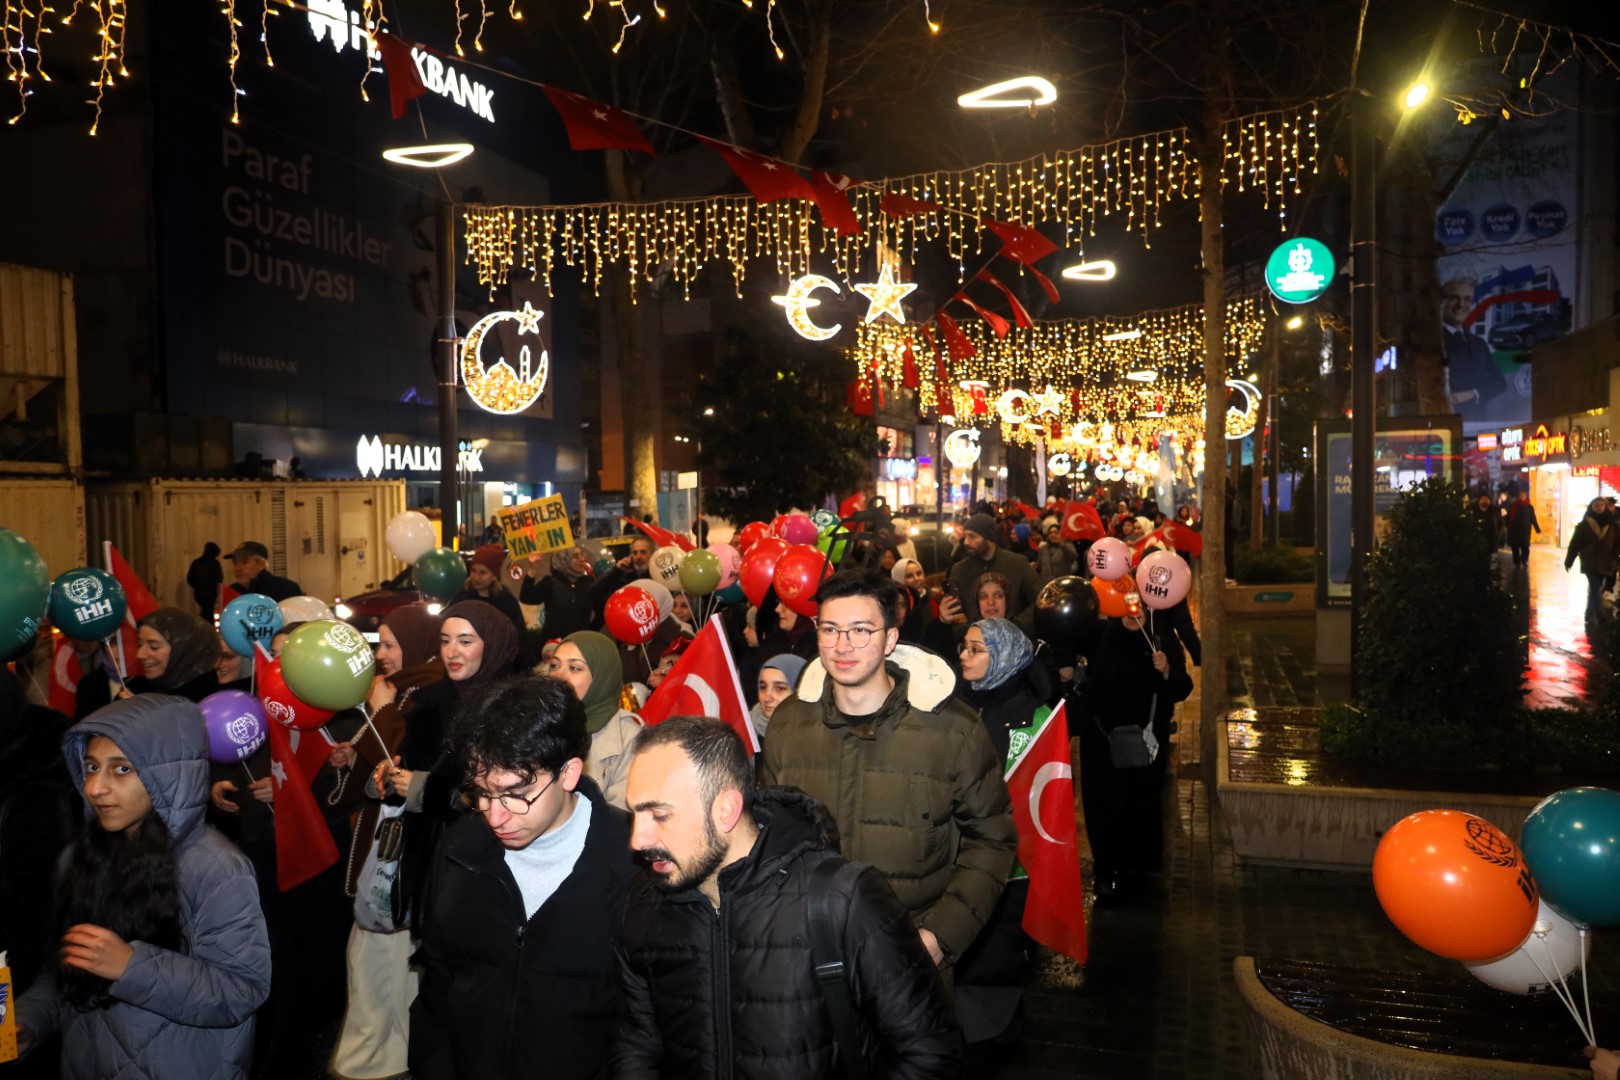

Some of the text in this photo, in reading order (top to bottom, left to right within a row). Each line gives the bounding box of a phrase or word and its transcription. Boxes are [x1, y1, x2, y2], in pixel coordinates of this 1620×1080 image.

[351, 10, 496, 123] HKBANK
[221, 127, 314, 194] Paraf
[221, 185, 393, 268] Güzellikler
[224, 236, 356, 303] Dünyası
[233, 353, 299, 374] HALKBANK
[501, 502, 566, 533] FENERLER
[508, 526, 567, 557] YANSIN
